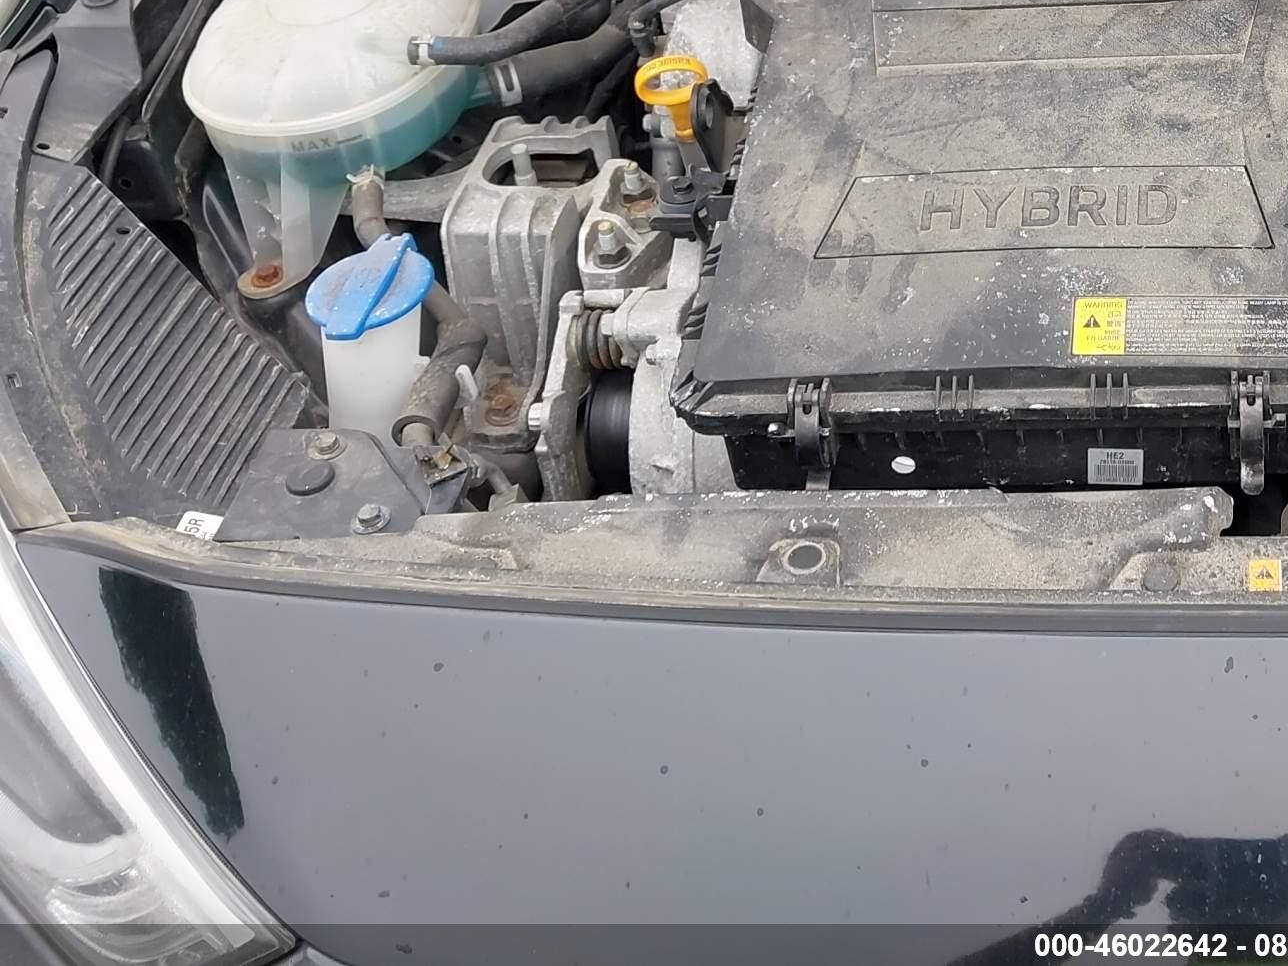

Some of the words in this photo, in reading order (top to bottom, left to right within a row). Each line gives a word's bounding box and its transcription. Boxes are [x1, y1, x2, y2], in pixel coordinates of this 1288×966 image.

[290, 137, 333, 153] MAX
[918, 183, 1179, 232] HYBRID
[1105, 451, 1125, 460] HE2
